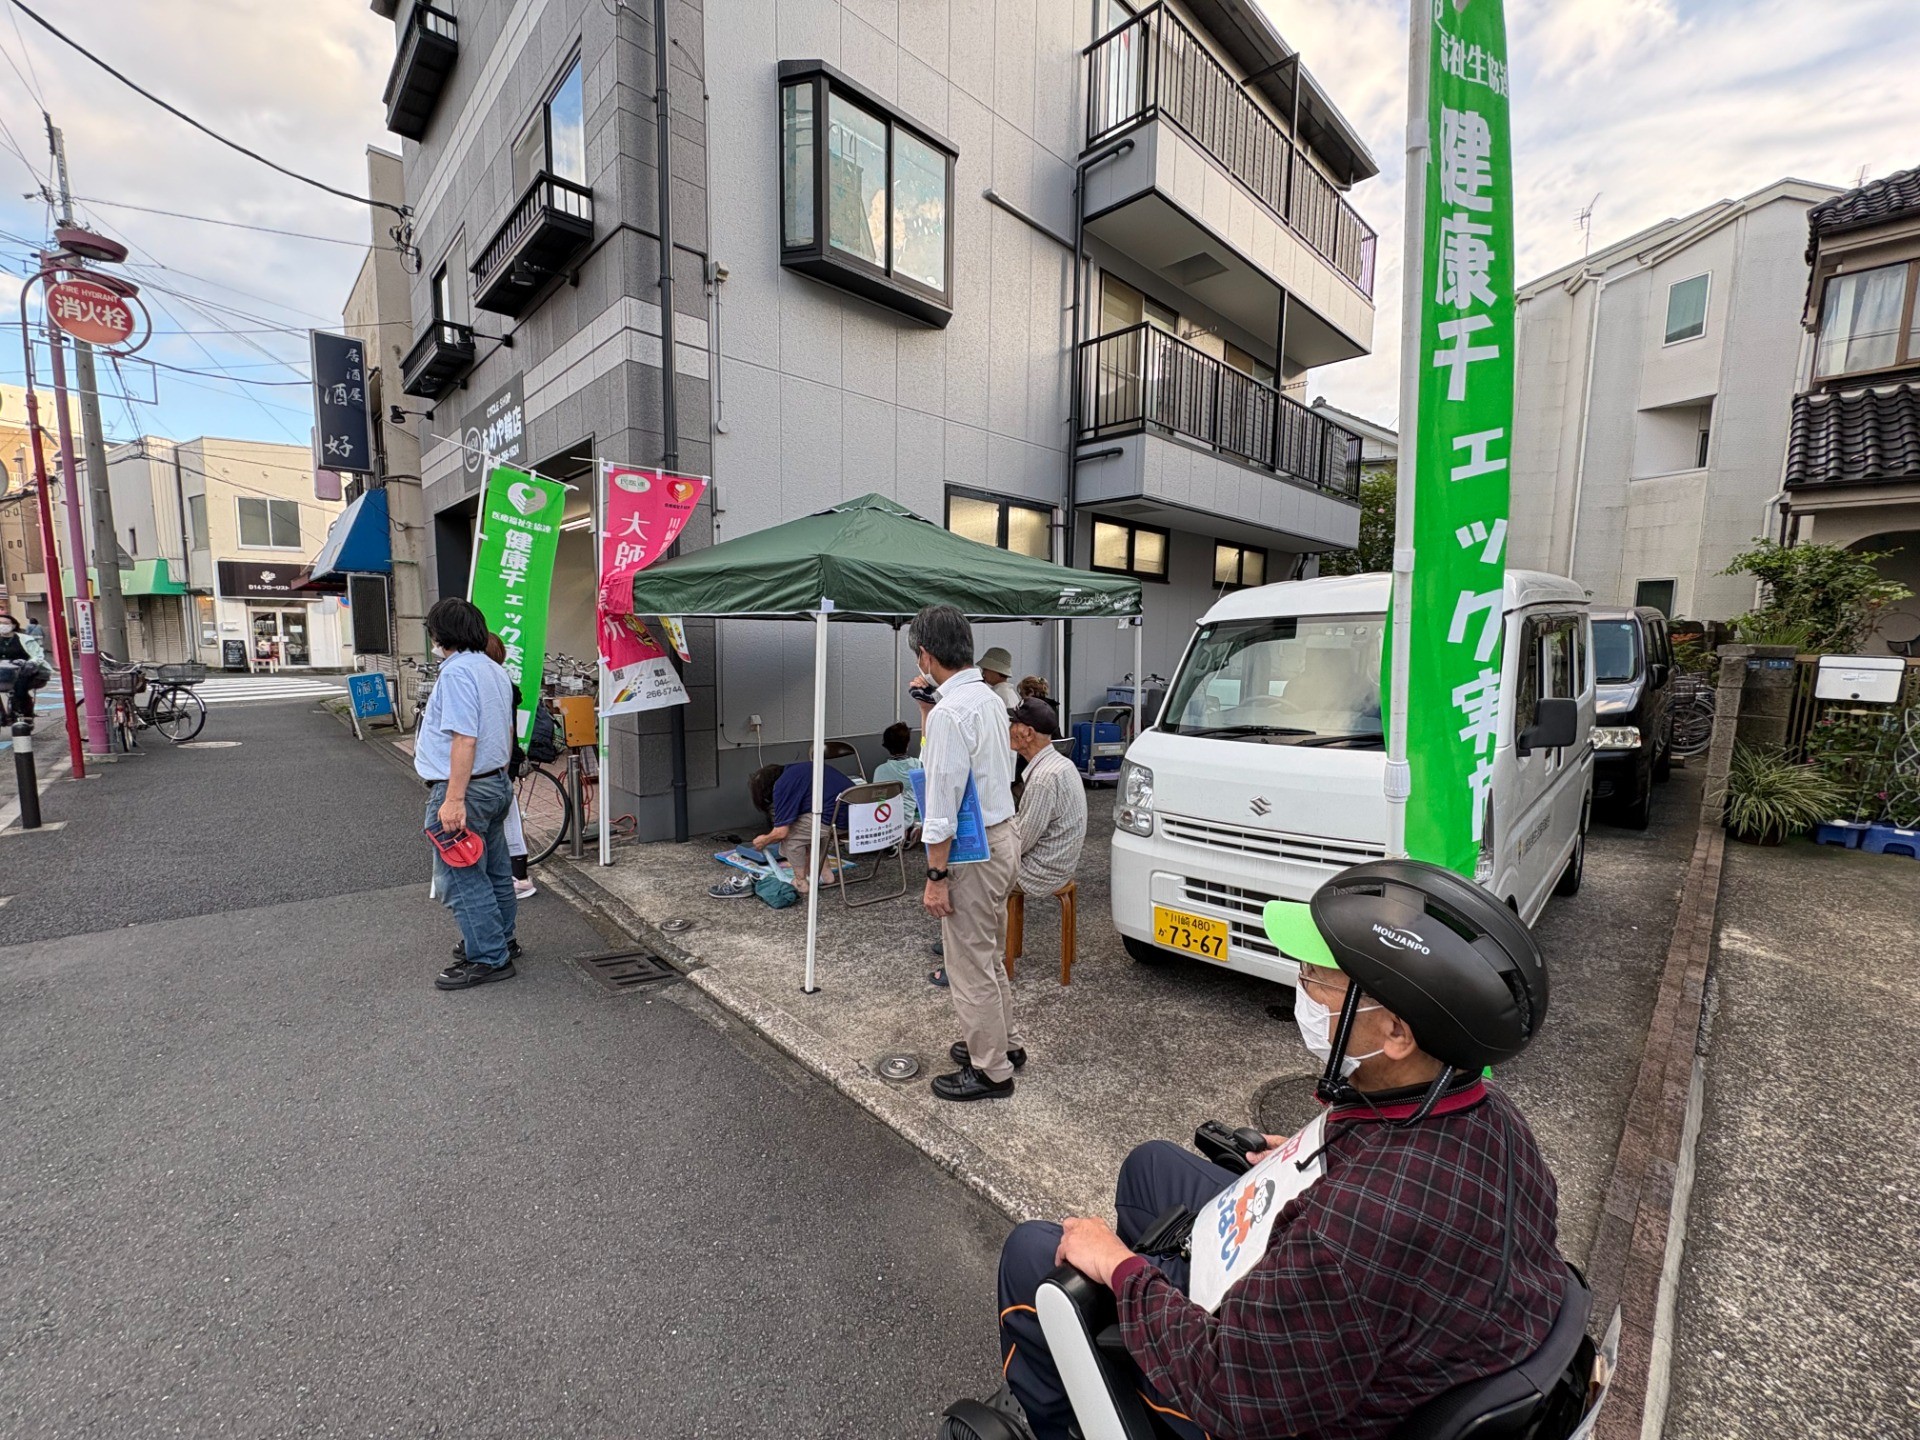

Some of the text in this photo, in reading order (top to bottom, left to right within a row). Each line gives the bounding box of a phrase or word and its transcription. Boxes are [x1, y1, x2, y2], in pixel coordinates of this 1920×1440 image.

[60, 284, 118, 304] FIRE HYDRANT
[55, 293, 128, 331] 消火栓
[345, 348, 363, 402] 居酒屋
[324, 383, 354, 458] 酒好
[1169, 925, 1223, 957] 73-67
[1372, 923, 1431, 955] MOUJANPO
